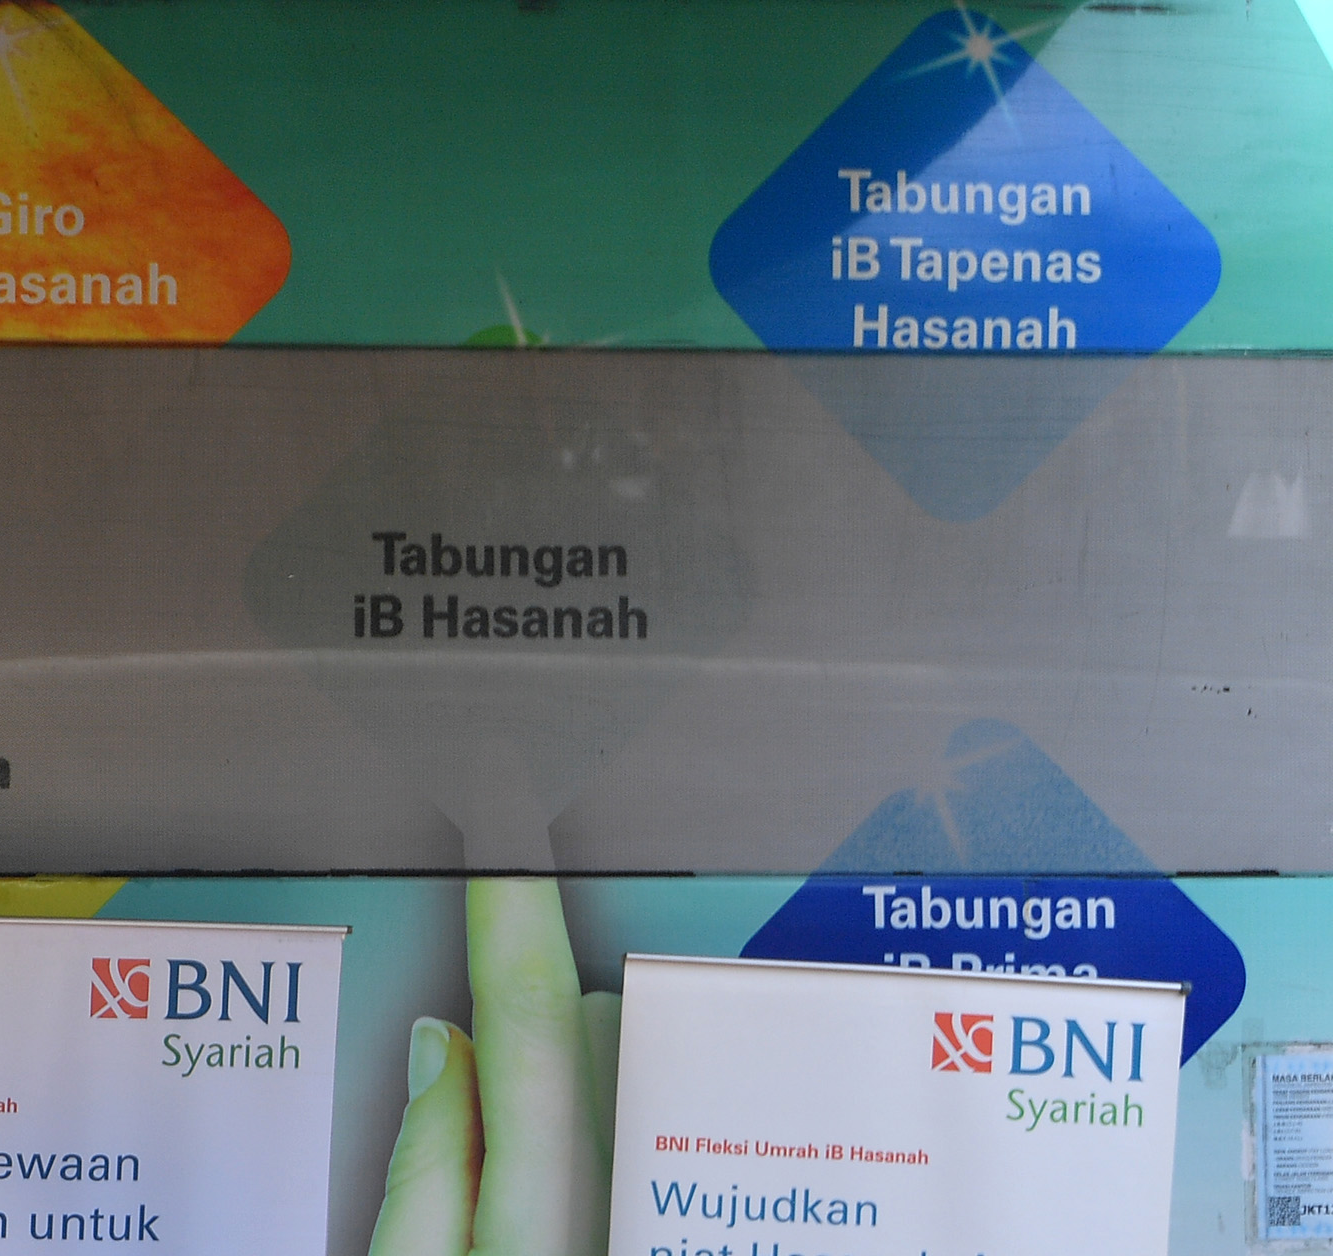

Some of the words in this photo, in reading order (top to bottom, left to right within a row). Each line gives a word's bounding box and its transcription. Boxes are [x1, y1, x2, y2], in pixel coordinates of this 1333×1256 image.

[837, 169, 1093, 226] Tabungan
[831, 238, 881, 280] iB
[889, 238, 1103, 291] Tapenas
[853, 306, 1077, 350] Hasanah
[371, 531, 628, 586] Tabungan
[352, 596, 405, 639] iB
[422, 597, 648, 641] Hasanah
[862, 885, 1116, 940] Tabungan
[164, 958, 303, 1025] BNI
[160, 1033, 302, 1078] Syariah
[1009, 1015, 1146, 1083] BNI
[1272, 1074, 1298, 1083] MASA
[1006, 1088, 1144, 1132] Syariah
[655, 1135, 689, 1152] BNI
[695, 1137, 749, 1155] Fleksi
[755, 1140, 819, 1160] Umrah
[825, 1144, 843, 1160] iB
[850, 1146, 930, 1165] Hasanah
[29, 1203, 161, 1242] untuk
[650, 1180, 878, 1228] Wujudkan
